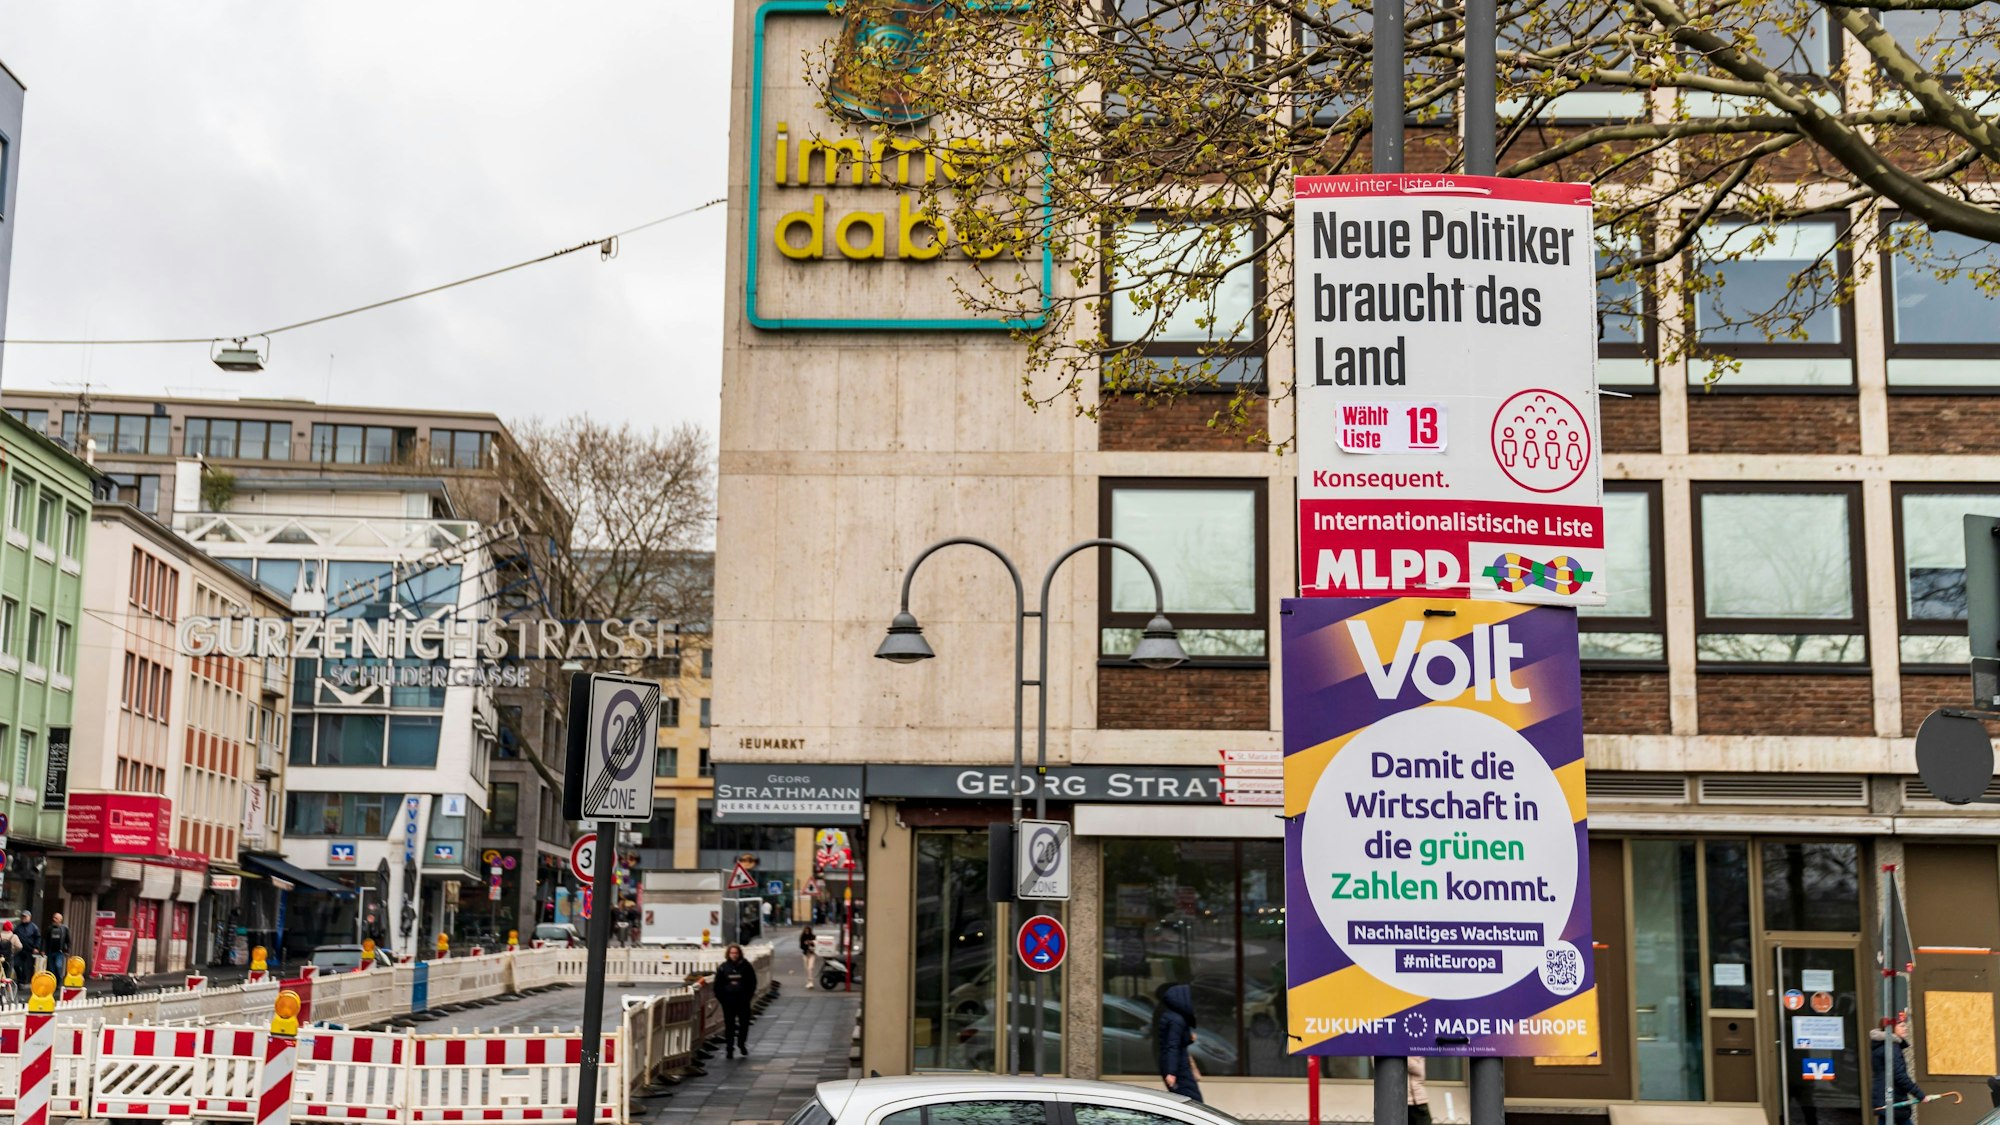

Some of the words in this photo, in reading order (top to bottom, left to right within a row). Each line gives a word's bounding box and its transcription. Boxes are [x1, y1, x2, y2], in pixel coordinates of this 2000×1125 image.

[1309, 177, 1455, 193] www.inter-liste.de
[1313, 211, 1410, 259] Neue
[1422, 210, 1574, 266] Politiker
[1314, 272, 1464, 322] braucht
[1476, 274, 1541, 327] das
[1315, 336, 1405, 386] Land
[1343, 406, 1388, 426] Wählt
[1406, 407, 1438, 444] 13
[1344, 429, 1380, 448] Liste
[1313, 470, 1450, 490] Konsequent.
[1314, 511, 1538, 535] Internationalistische
[1545, 517, 1593, 538] Liste
[1314, 549, 1461, 590] MLPD
[179, 602, 680, 660] GÜRZENICHSTRASSE
[1345, 620, 1532, 704] Volt
[611, 713, 636, 756] 20
[1371, 750, 1464, 779] Damit
[1471, 751, 1514, 780] die
[767, 774, 811, 783] GEORG
[956, 770, 1087, 796] GEORG
[601, 787, 637, 810] ZONE
[718, 784, 860, 799] STRATHMANN
[721, 803, 855, 811] HERRENAUSSTATTER
[1345, 790, 1508, 820] Wirtschaft
[1514, 792, 1538, 821] in
[580, 848, 593, 869] 3
[1036, 841, 1056, 864] 20
[1364, 830, 1412, 859] die
[1419, 831, 1524, 866] grünen
[1032, 880, 1058, 893] ZONE
[1331, 870, 1438, 900] Zahlen
[1446, 871, 1556, 902] kommt.
[1354, 924, 1458, 943] Nachhaltiges
[1461, 925, 1538, 942] Wachstum
[1403, 953, 1496, 972] #mitEuropa
[1304, 1017, 1396, 1034] ZUKUNFT
[1434, 1018, 1491, 1035] MADE
[1495, 1018, 1514, 1035] IN
[1518, 1019, 1587, 1035] EUROPE
